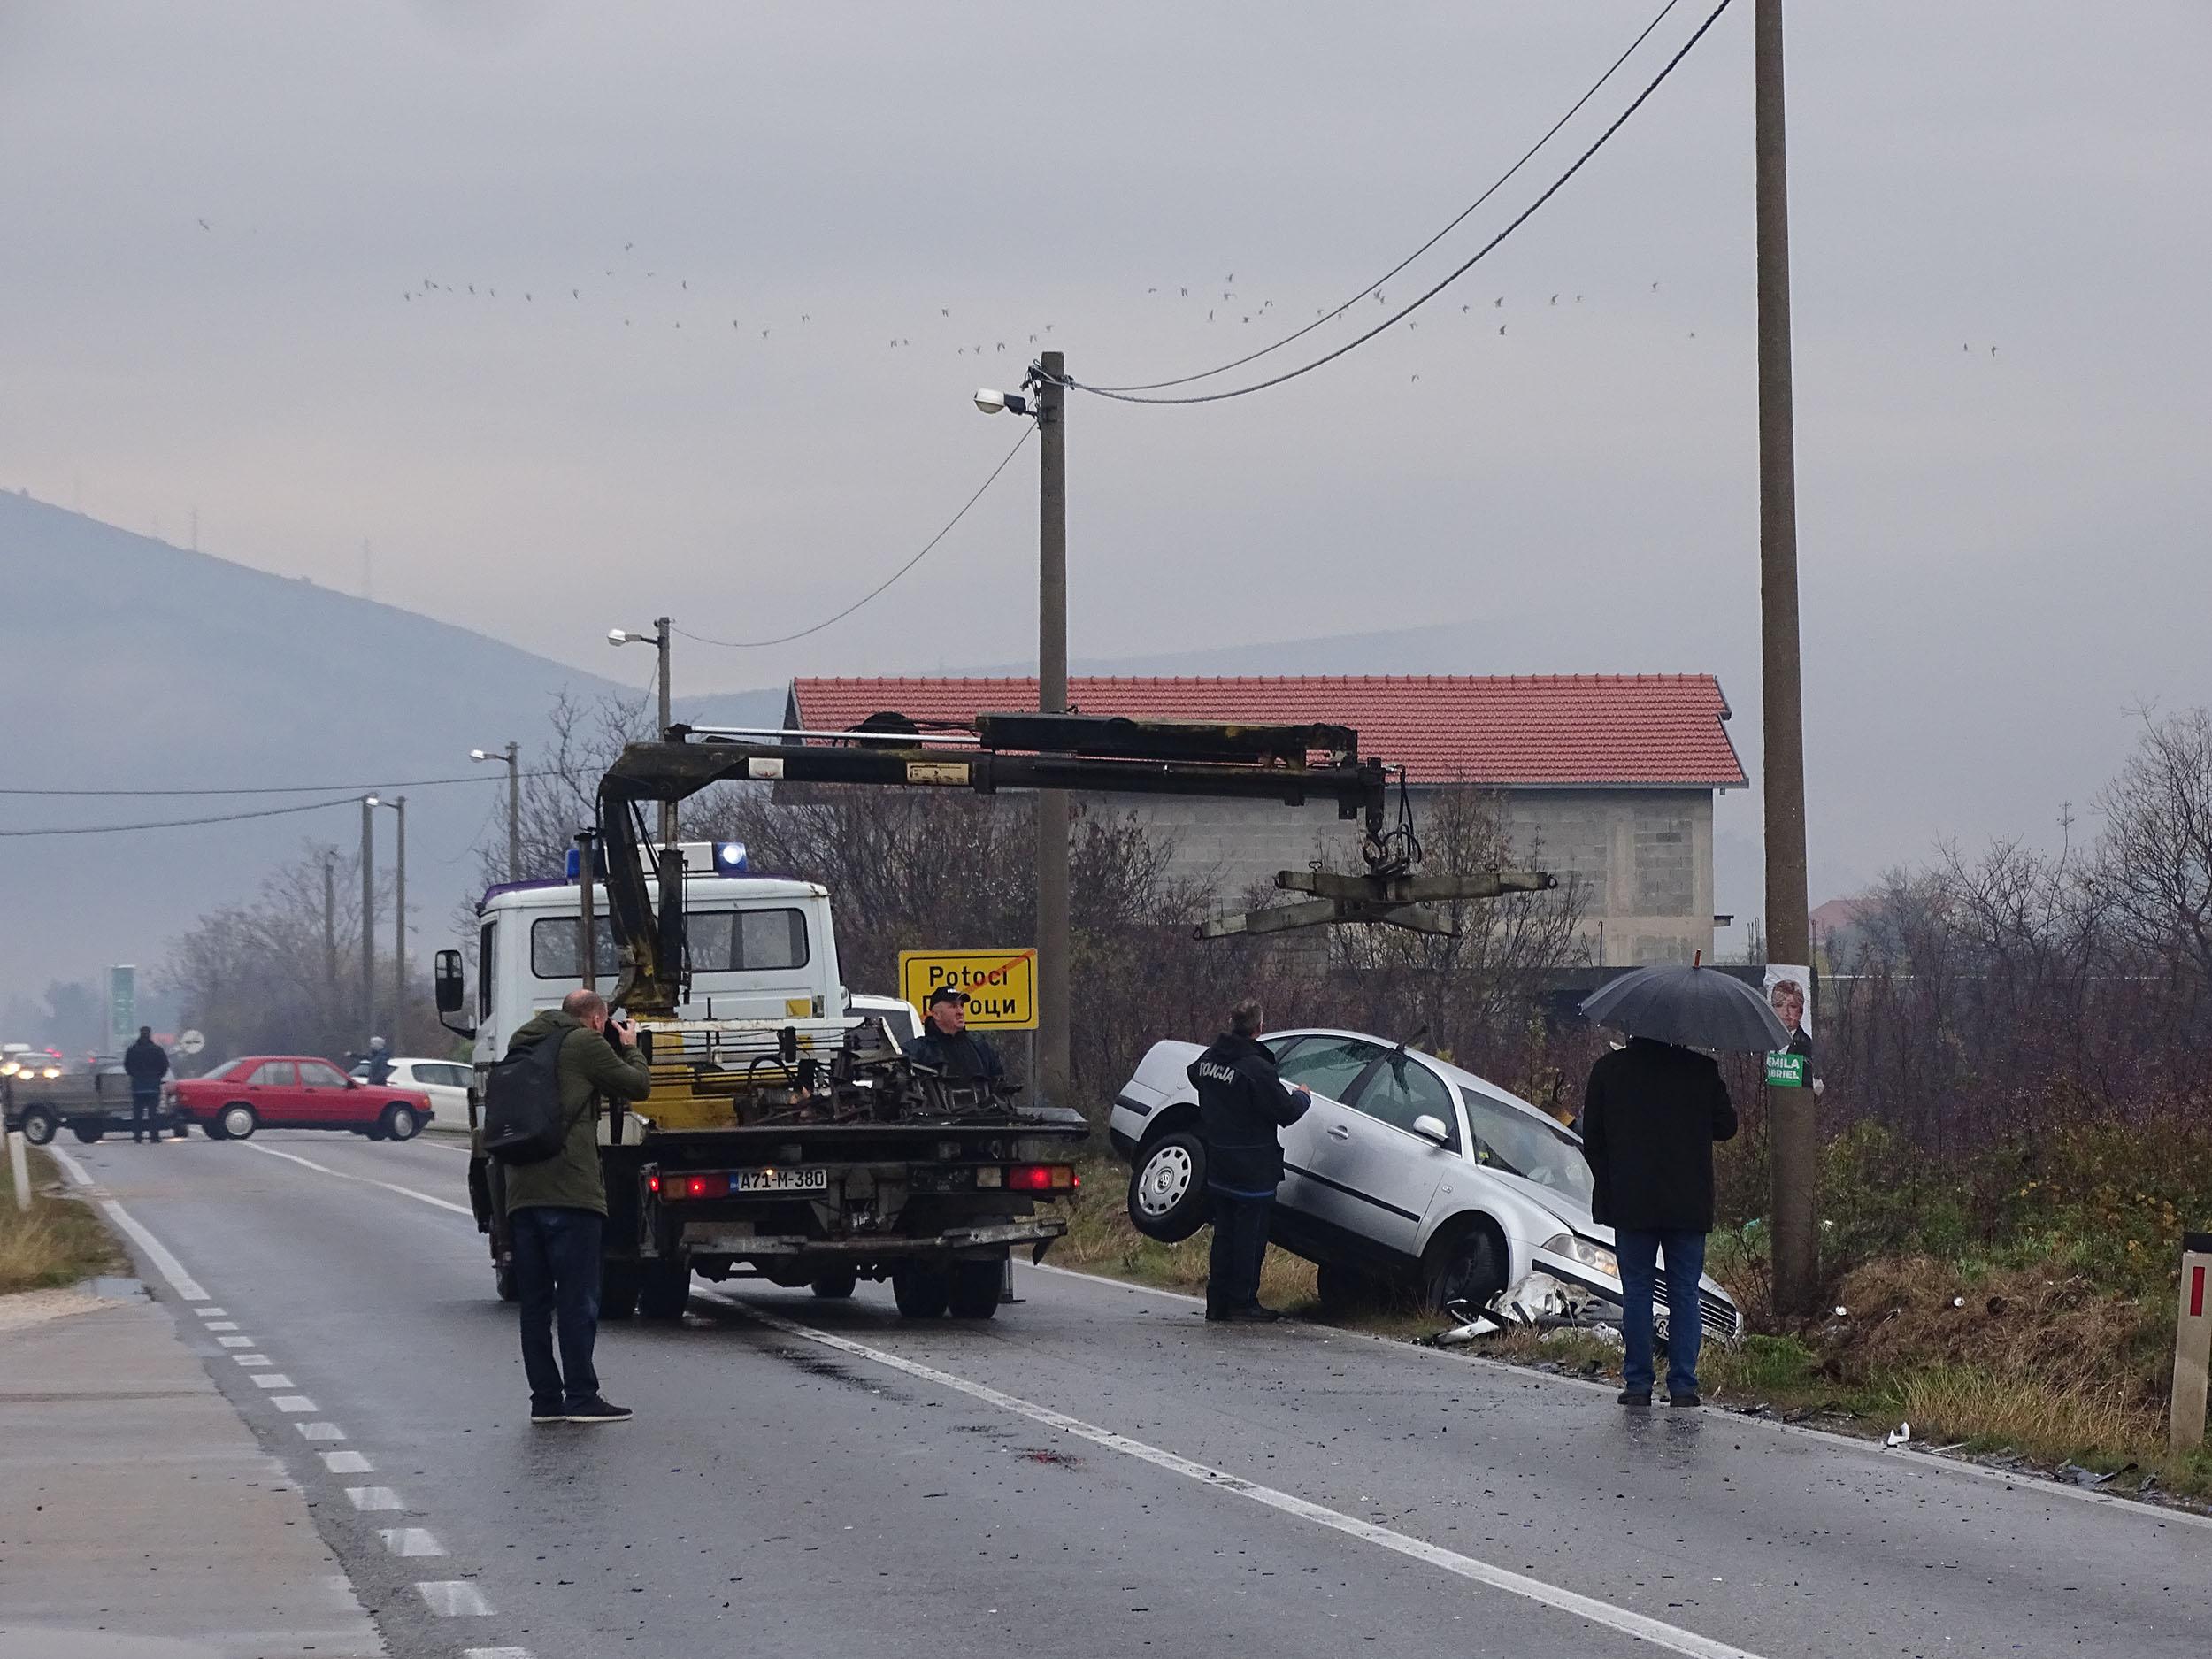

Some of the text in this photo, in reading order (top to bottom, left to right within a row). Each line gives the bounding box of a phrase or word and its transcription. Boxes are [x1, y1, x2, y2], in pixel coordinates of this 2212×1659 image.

[929, 966, 1008, 987] Potoci
[922, 995, 1016, 1018] Поци
[741, 1171, 825, 1188] A71-M-380
